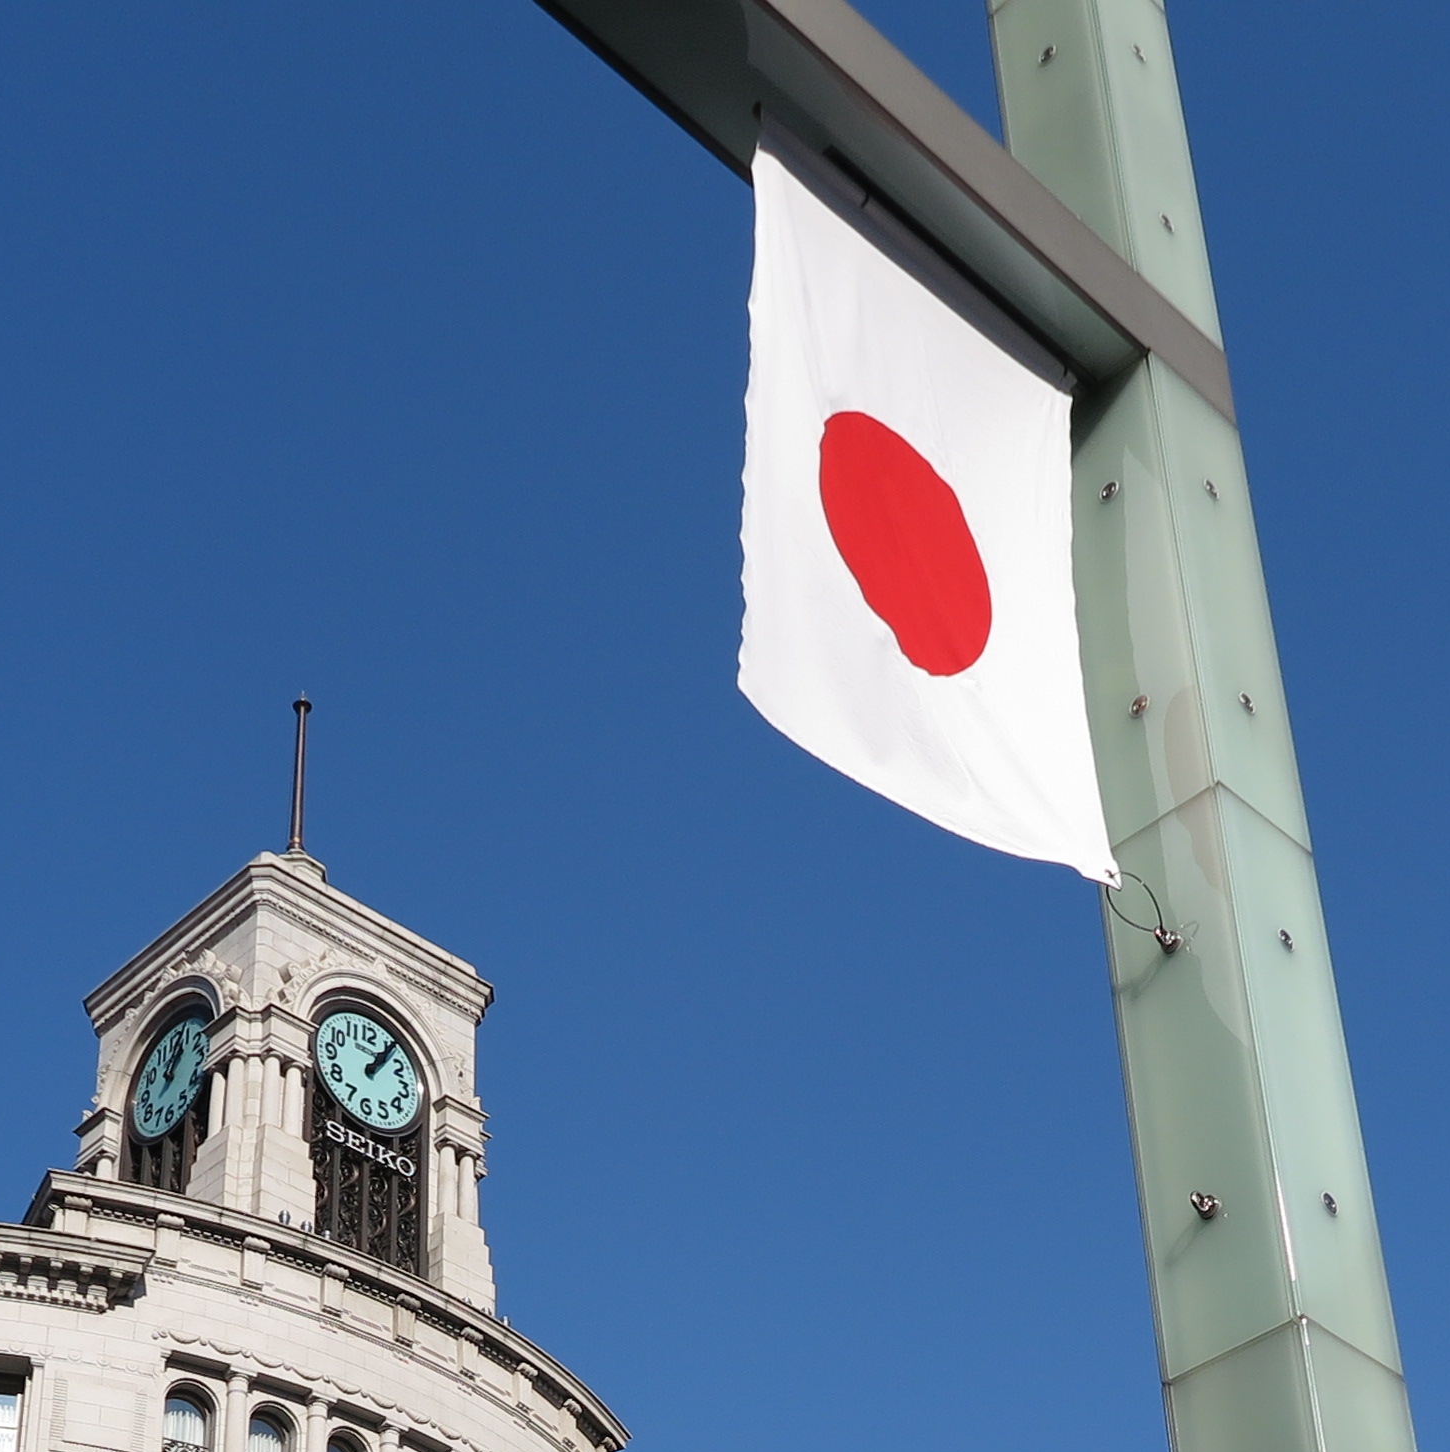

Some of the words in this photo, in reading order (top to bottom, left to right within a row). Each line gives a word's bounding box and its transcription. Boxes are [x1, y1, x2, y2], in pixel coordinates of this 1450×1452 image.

[331, 1026, 345, 1047] 10
[346, 1020, 358, 1041] 11
[362, 1024, 377, 1046] 12
[192, 1031, 202, 1052] 2
[325, 1042, 337, 1060] 9
[145, 1067, 157, 1088] 10
[330, 1063, 343, 1083] 8
[393, 1059, 404, 1078] 2
[140, 1089, 150, 1108] 9
[178, 1088, 187, 1109] 5
[345, 1083, 358, 1102] 7
[398, 1081, 410, 1099] 3
[143, 1103, 153, 1123] 8
[165, 1103, 174, 1123] 6
[360, 1097, 373, 1116] 6
[377, 1101, 390, 1120] 5
[390, 1096, 404, 1114] 4
[154, 1106, 164, 1128] 7
[326, 1120, 416, 1177] SEIKO
